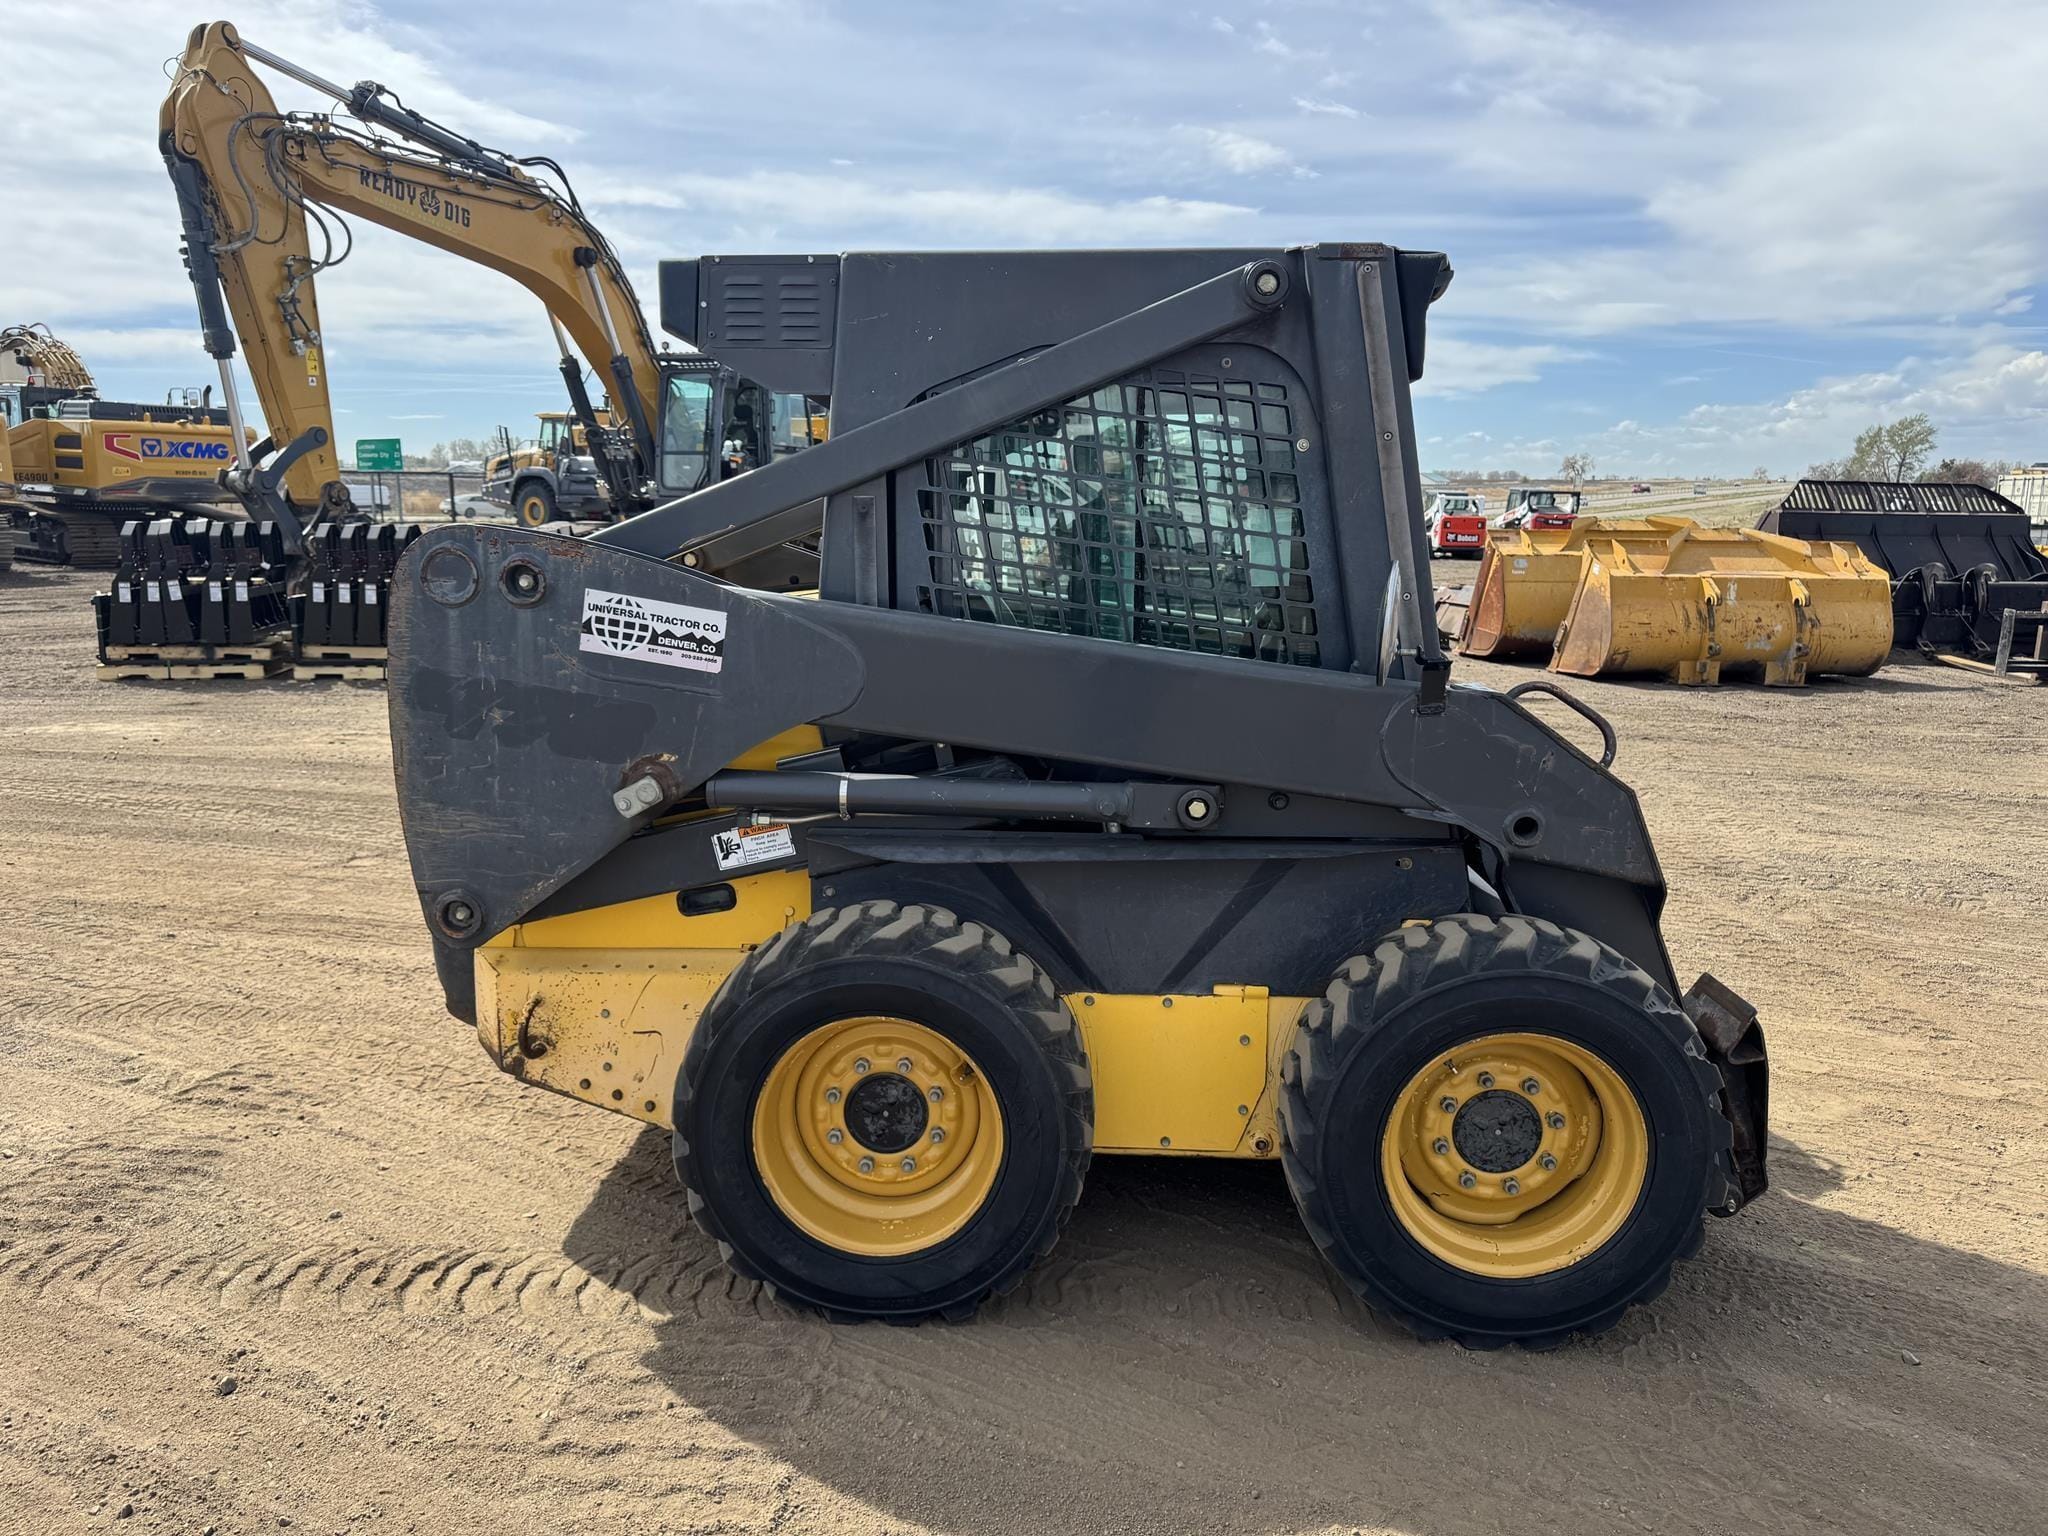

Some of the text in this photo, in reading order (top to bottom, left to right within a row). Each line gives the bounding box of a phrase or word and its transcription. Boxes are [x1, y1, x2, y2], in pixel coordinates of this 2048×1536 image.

[359, 165, 416, 205] READY
[444, 200, 471, 228] DIG
[163, 441, 229, 459] XCMG
[1457, 534, 1478, 542] Bobcat
[588, 602, 721, 634] UNIVERSAL TRACTOR CO.
[658, 636, 716, 653] DENVER, CO
